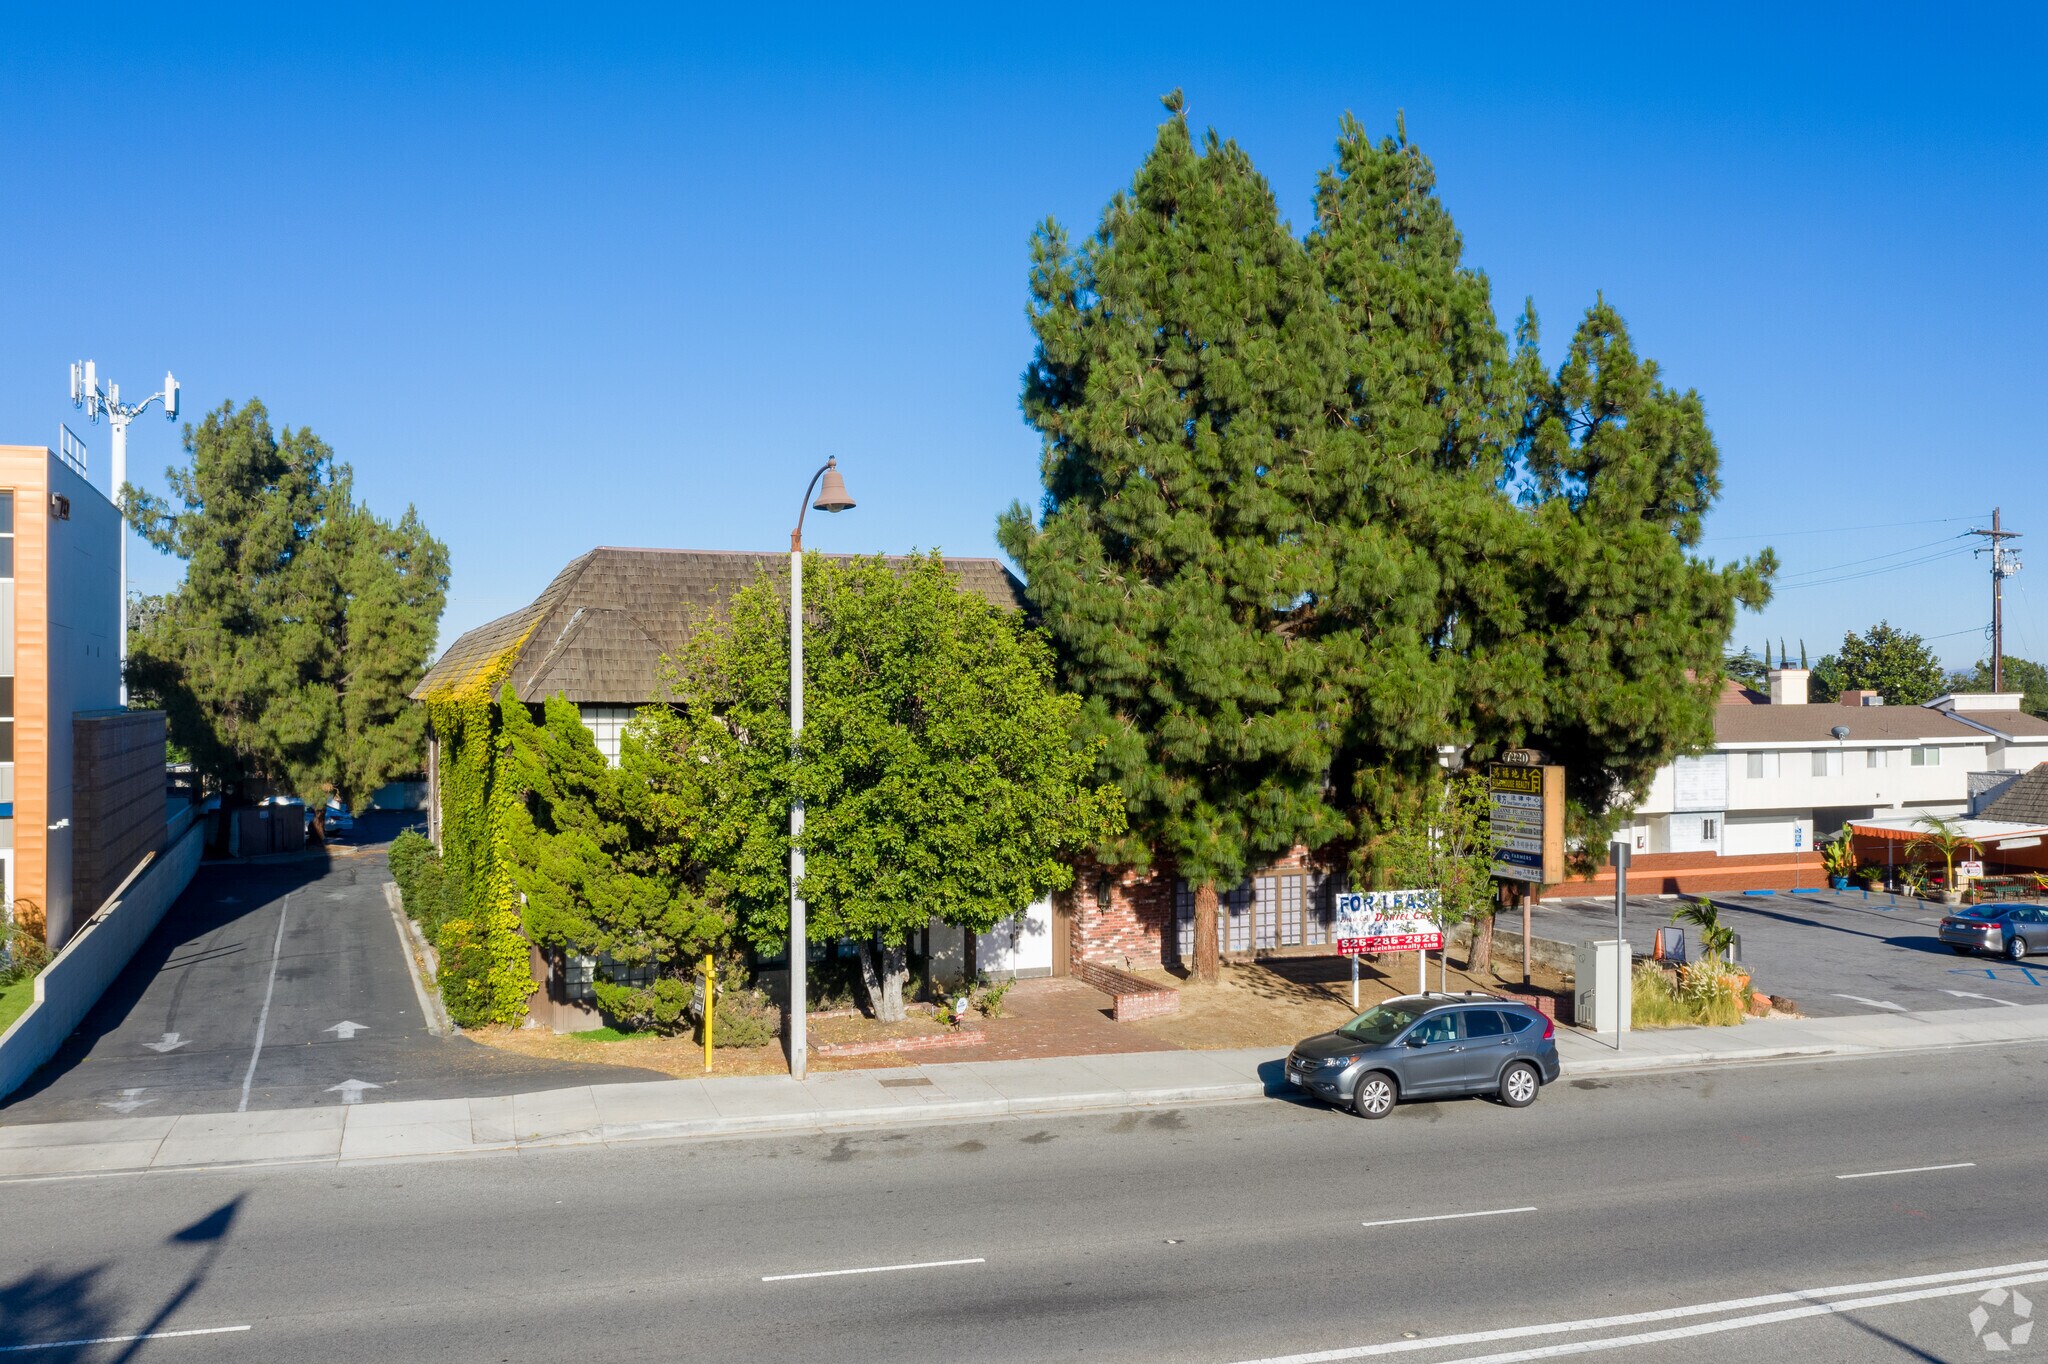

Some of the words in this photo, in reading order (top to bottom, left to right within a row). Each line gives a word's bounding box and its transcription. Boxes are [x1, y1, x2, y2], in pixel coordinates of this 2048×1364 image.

[1504, 752, 1528, 763] 7220
[1515, 780, 1529, 789] REALTY
[1511, 853, 1531, 861] FARMERS
[1340, 895, 1374, 913] FOR
